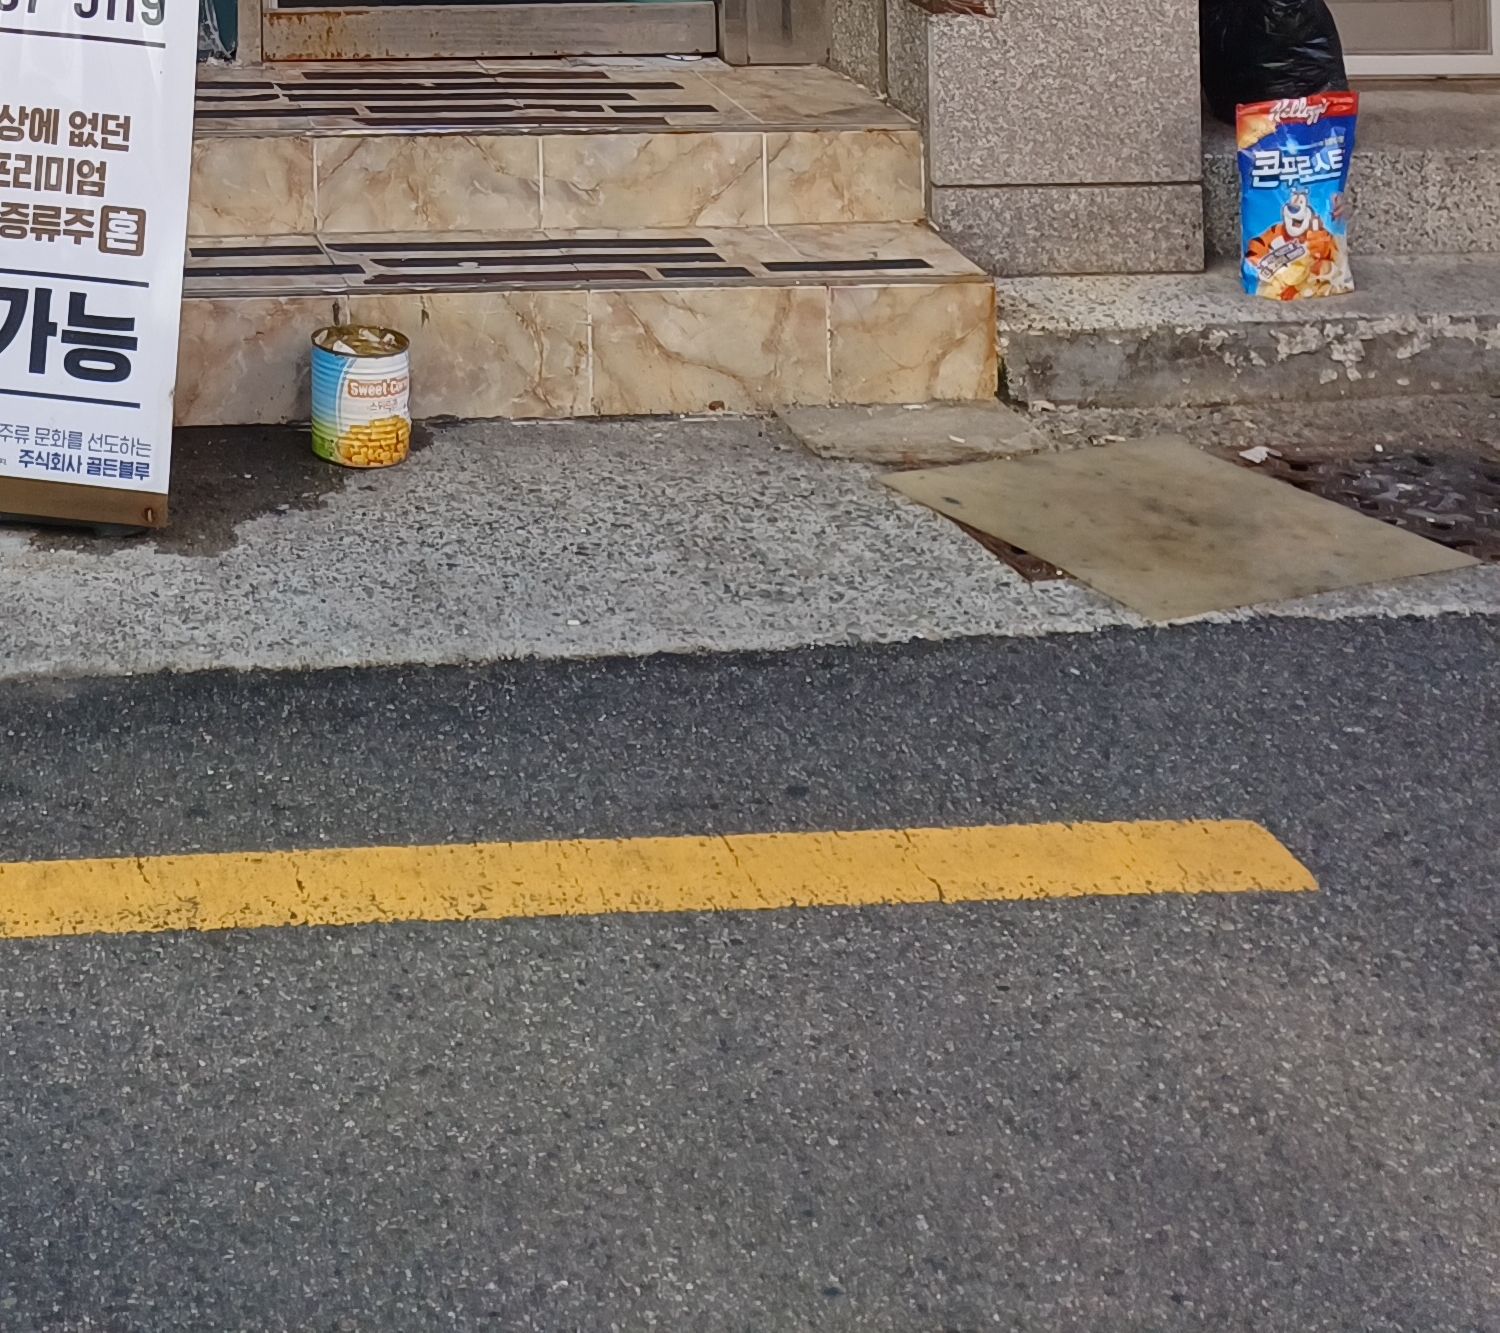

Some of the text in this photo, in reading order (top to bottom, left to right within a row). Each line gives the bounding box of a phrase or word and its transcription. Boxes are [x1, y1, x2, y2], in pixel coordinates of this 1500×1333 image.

[68, 111, 131, 152] 없던
[1251, 148, 1344, 189] 콘푸로스트
[350, 381, 388, 397] Sweet
[34, 427, 83, 450] 문화를
[88, 433, 152, 458] 선도하는
[19, 449, 151, 481] 주식회사 골든블루
